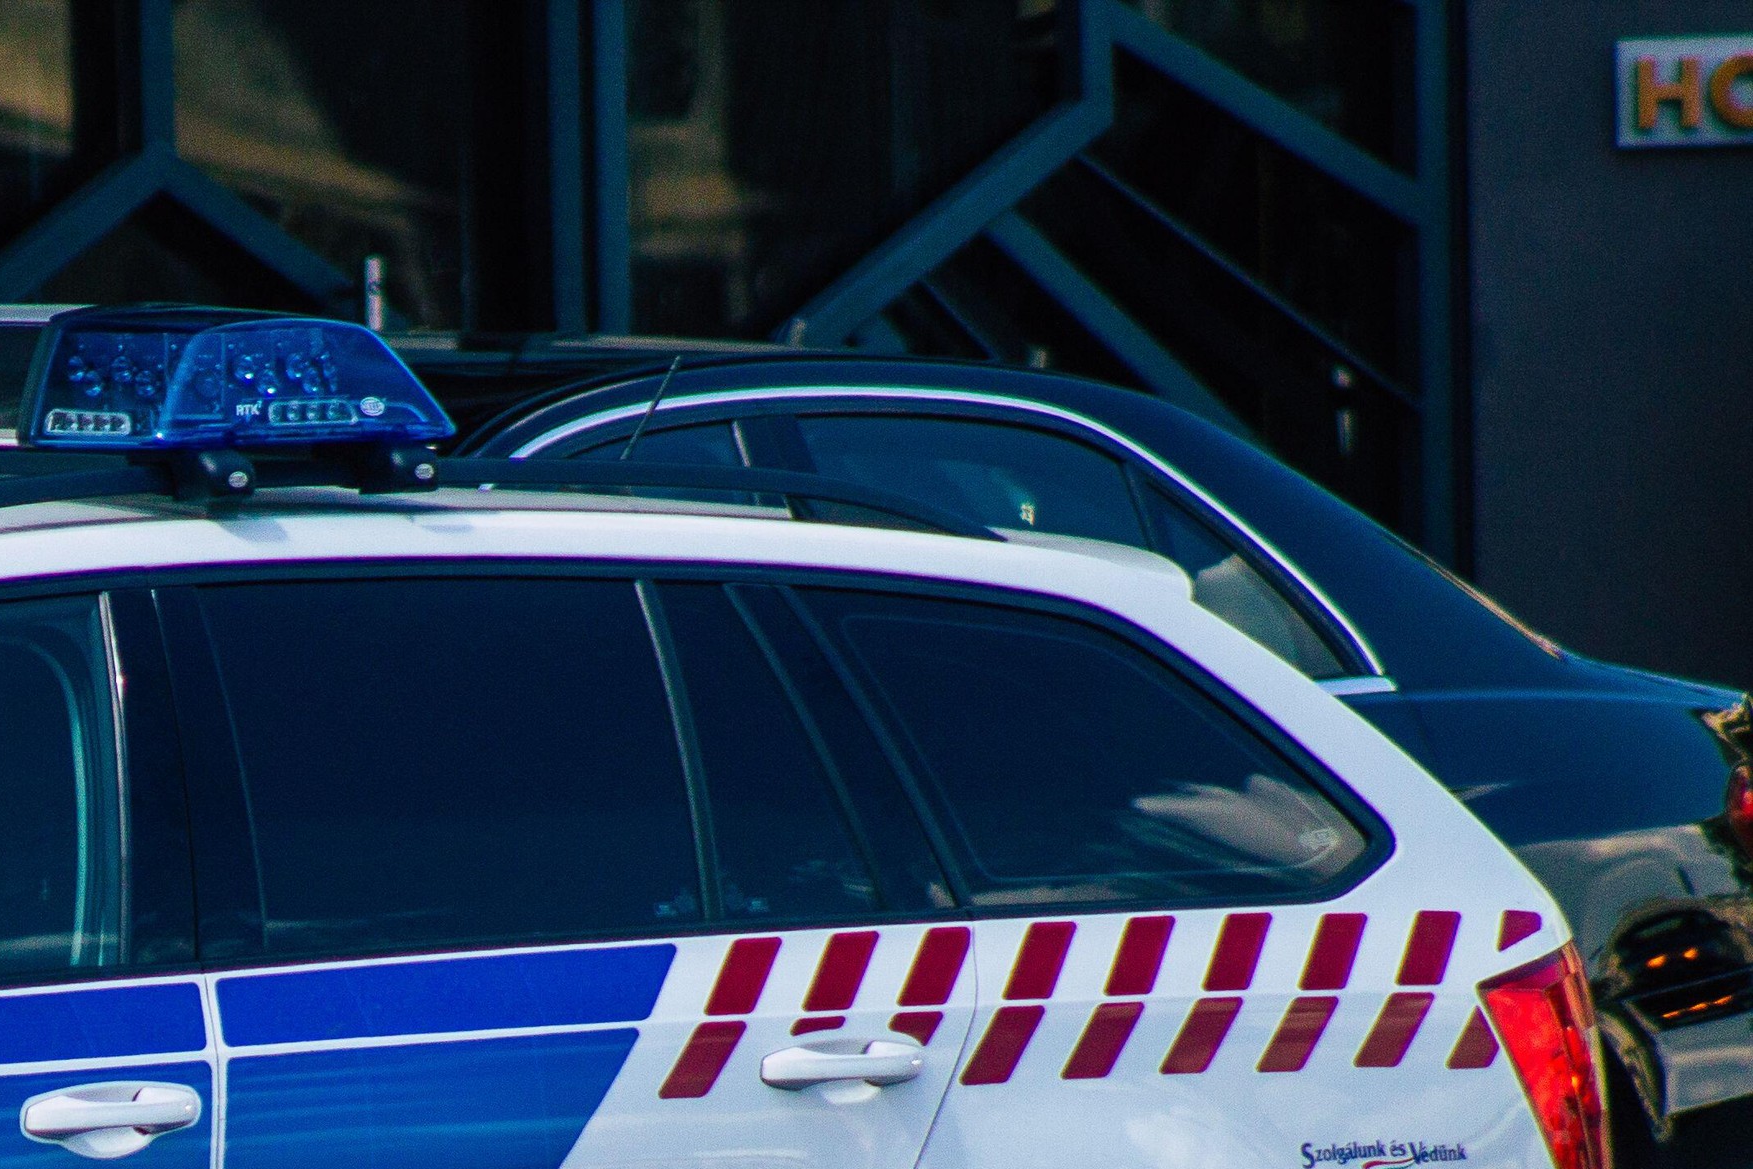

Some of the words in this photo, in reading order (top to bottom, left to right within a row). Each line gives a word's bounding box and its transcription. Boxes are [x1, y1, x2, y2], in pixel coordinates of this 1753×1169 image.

[1301, 1140, 1386, 1169] Szolgálunk
[1390, 1140, 1406, 1157] és
[1408, 1141, 1467, 1164] Védünk
